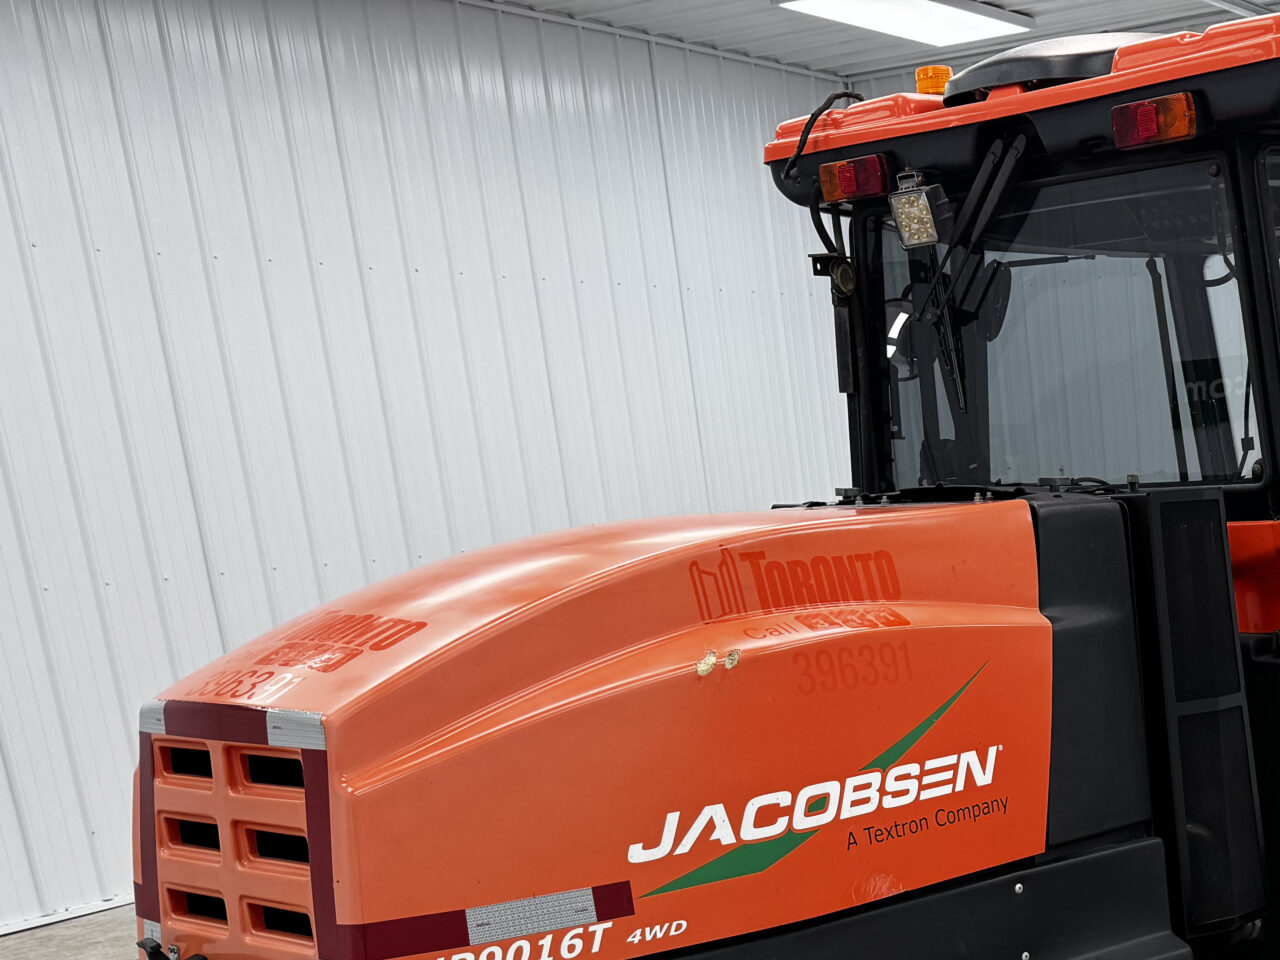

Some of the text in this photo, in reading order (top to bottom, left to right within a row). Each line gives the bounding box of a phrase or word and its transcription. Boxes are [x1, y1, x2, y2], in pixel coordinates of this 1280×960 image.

[739, 550, 902, 615] TORONTO
[743, 621, 799, 639] Call
[185, 669, 307, 703] 396391
[793, 641, 913, 696] 396391
[627, 745, 999, 863] JACOBSEN
[846, 796, 1009, 851] A Textron Company
[626, 920, 688, 945] 4WD
